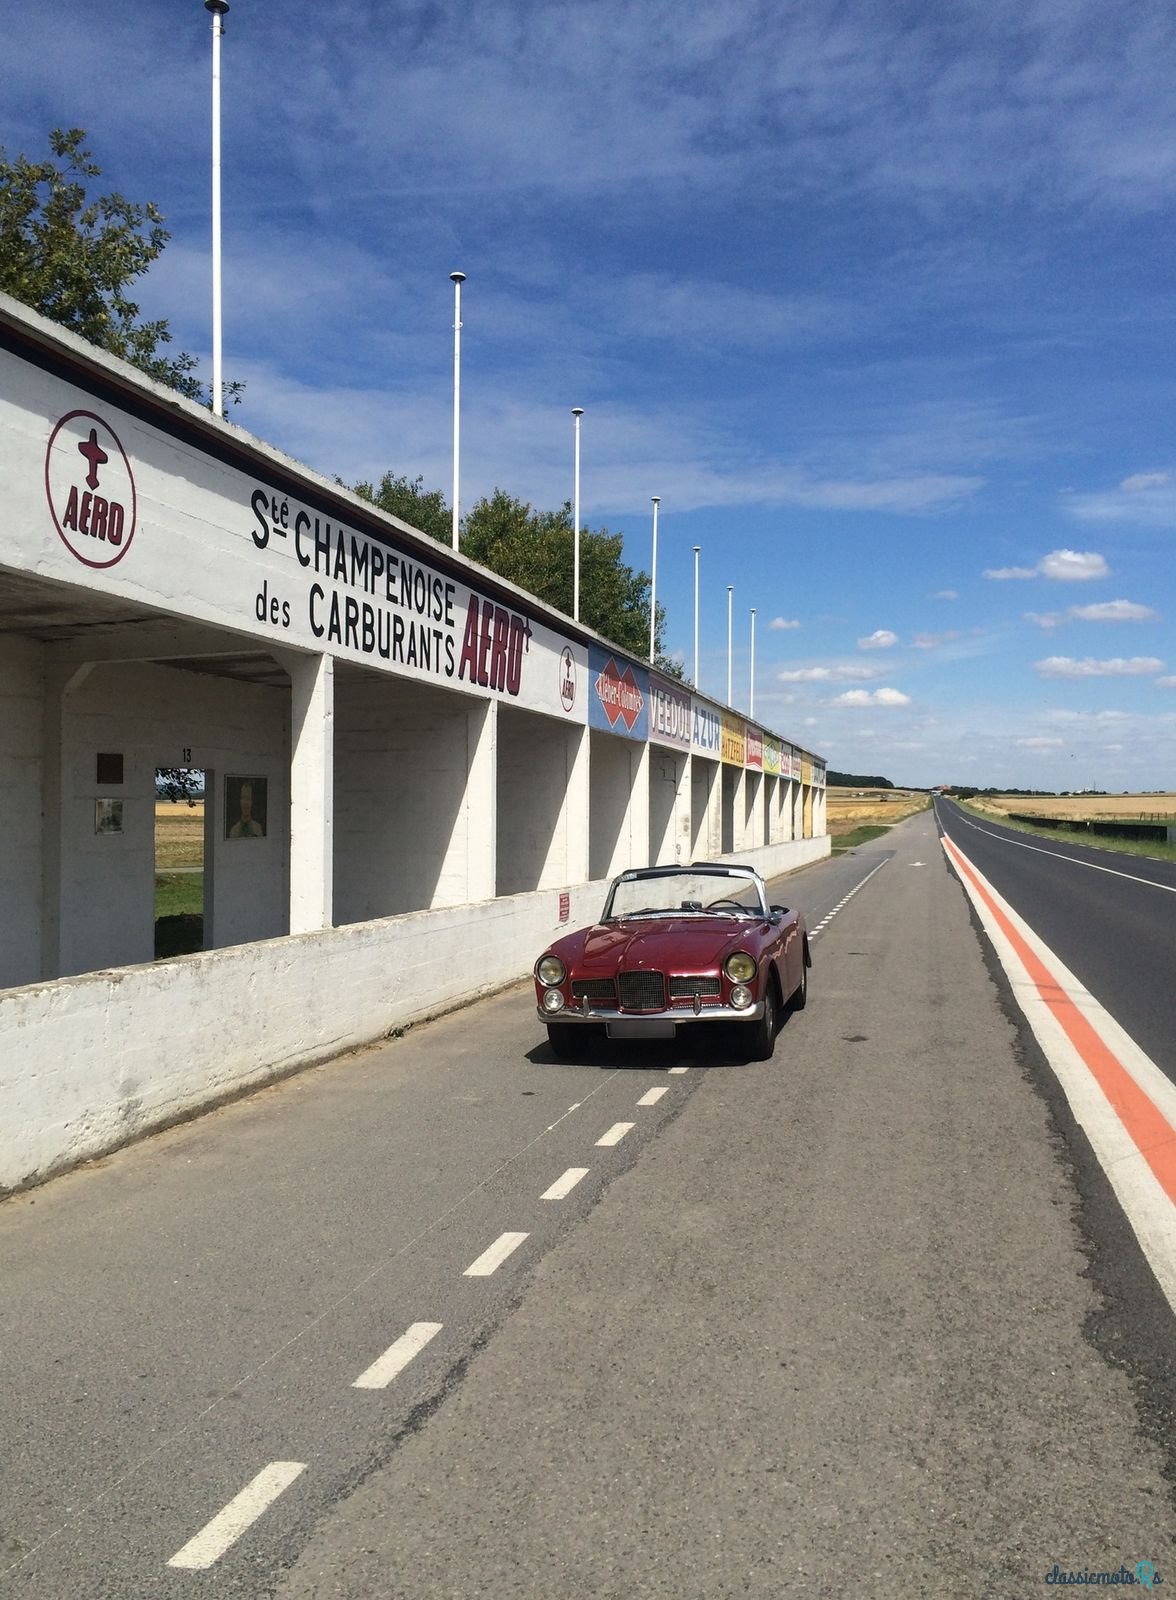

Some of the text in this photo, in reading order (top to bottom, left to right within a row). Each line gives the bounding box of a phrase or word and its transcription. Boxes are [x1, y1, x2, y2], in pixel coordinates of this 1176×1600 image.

[62, 485, 125, 546] AERO
[251, 489, 456, 628] Sté CHAMPENOISE
[256, 580, 455, 677] des CARBURANTS
[458, 593, 524, 697] AERO
[649, 685, 691, 743] VEEDOL
[692, 705, 720, 751] AZUR
[182, 748, 192, 763] 13
